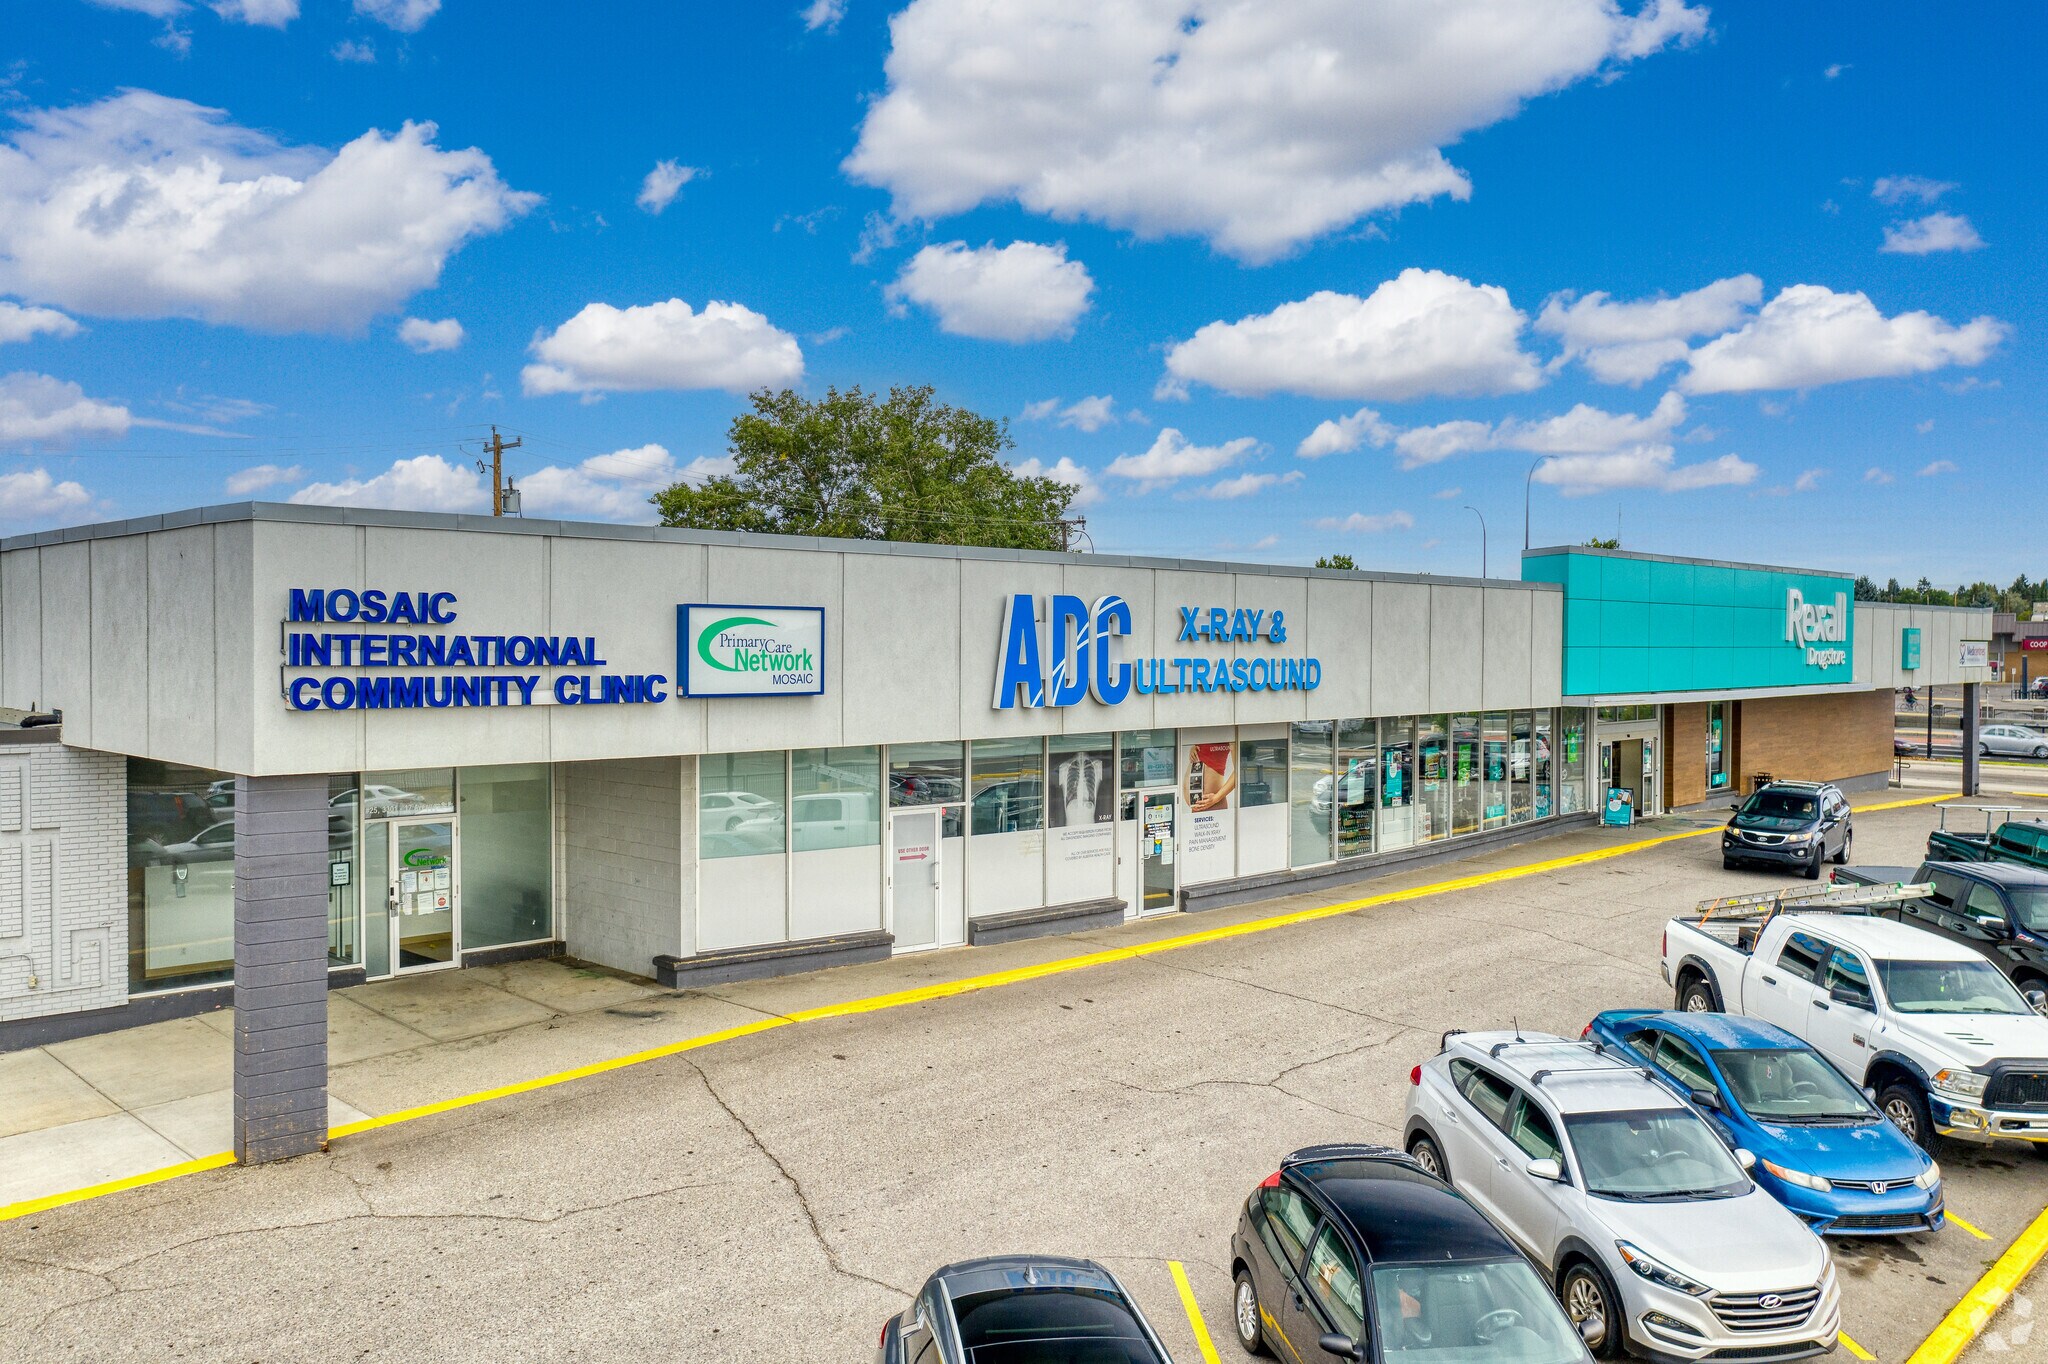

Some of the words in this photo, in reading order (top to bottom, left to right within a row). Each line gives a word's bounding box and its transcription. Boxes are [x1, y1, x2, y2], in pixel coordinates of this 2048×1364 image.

[289, 588, 457, 624] MOSAIC
[1785, 587, 1847, 649] Rexall
[1178, 606, 1264, 642] X-RAY
[1268, 609, 1288, 643] &
[289, 634, 606, 667] INTERNATIONAL
[719, 633, 766, 653] Primary
[765, 639, 792, 654] Care
[734, 648, 814, 672] Network
[992, 593, 1132, 710] ADC
[1806, 647, 1846, 670] Drugstore
[290, 675, 540, 711] COMMUNITY
[554, 674, 668, 706] CLINIC
[772, 673, 814, 685] MOSAIC
[1135, 657, 1322, 694] ULTRASOUND
